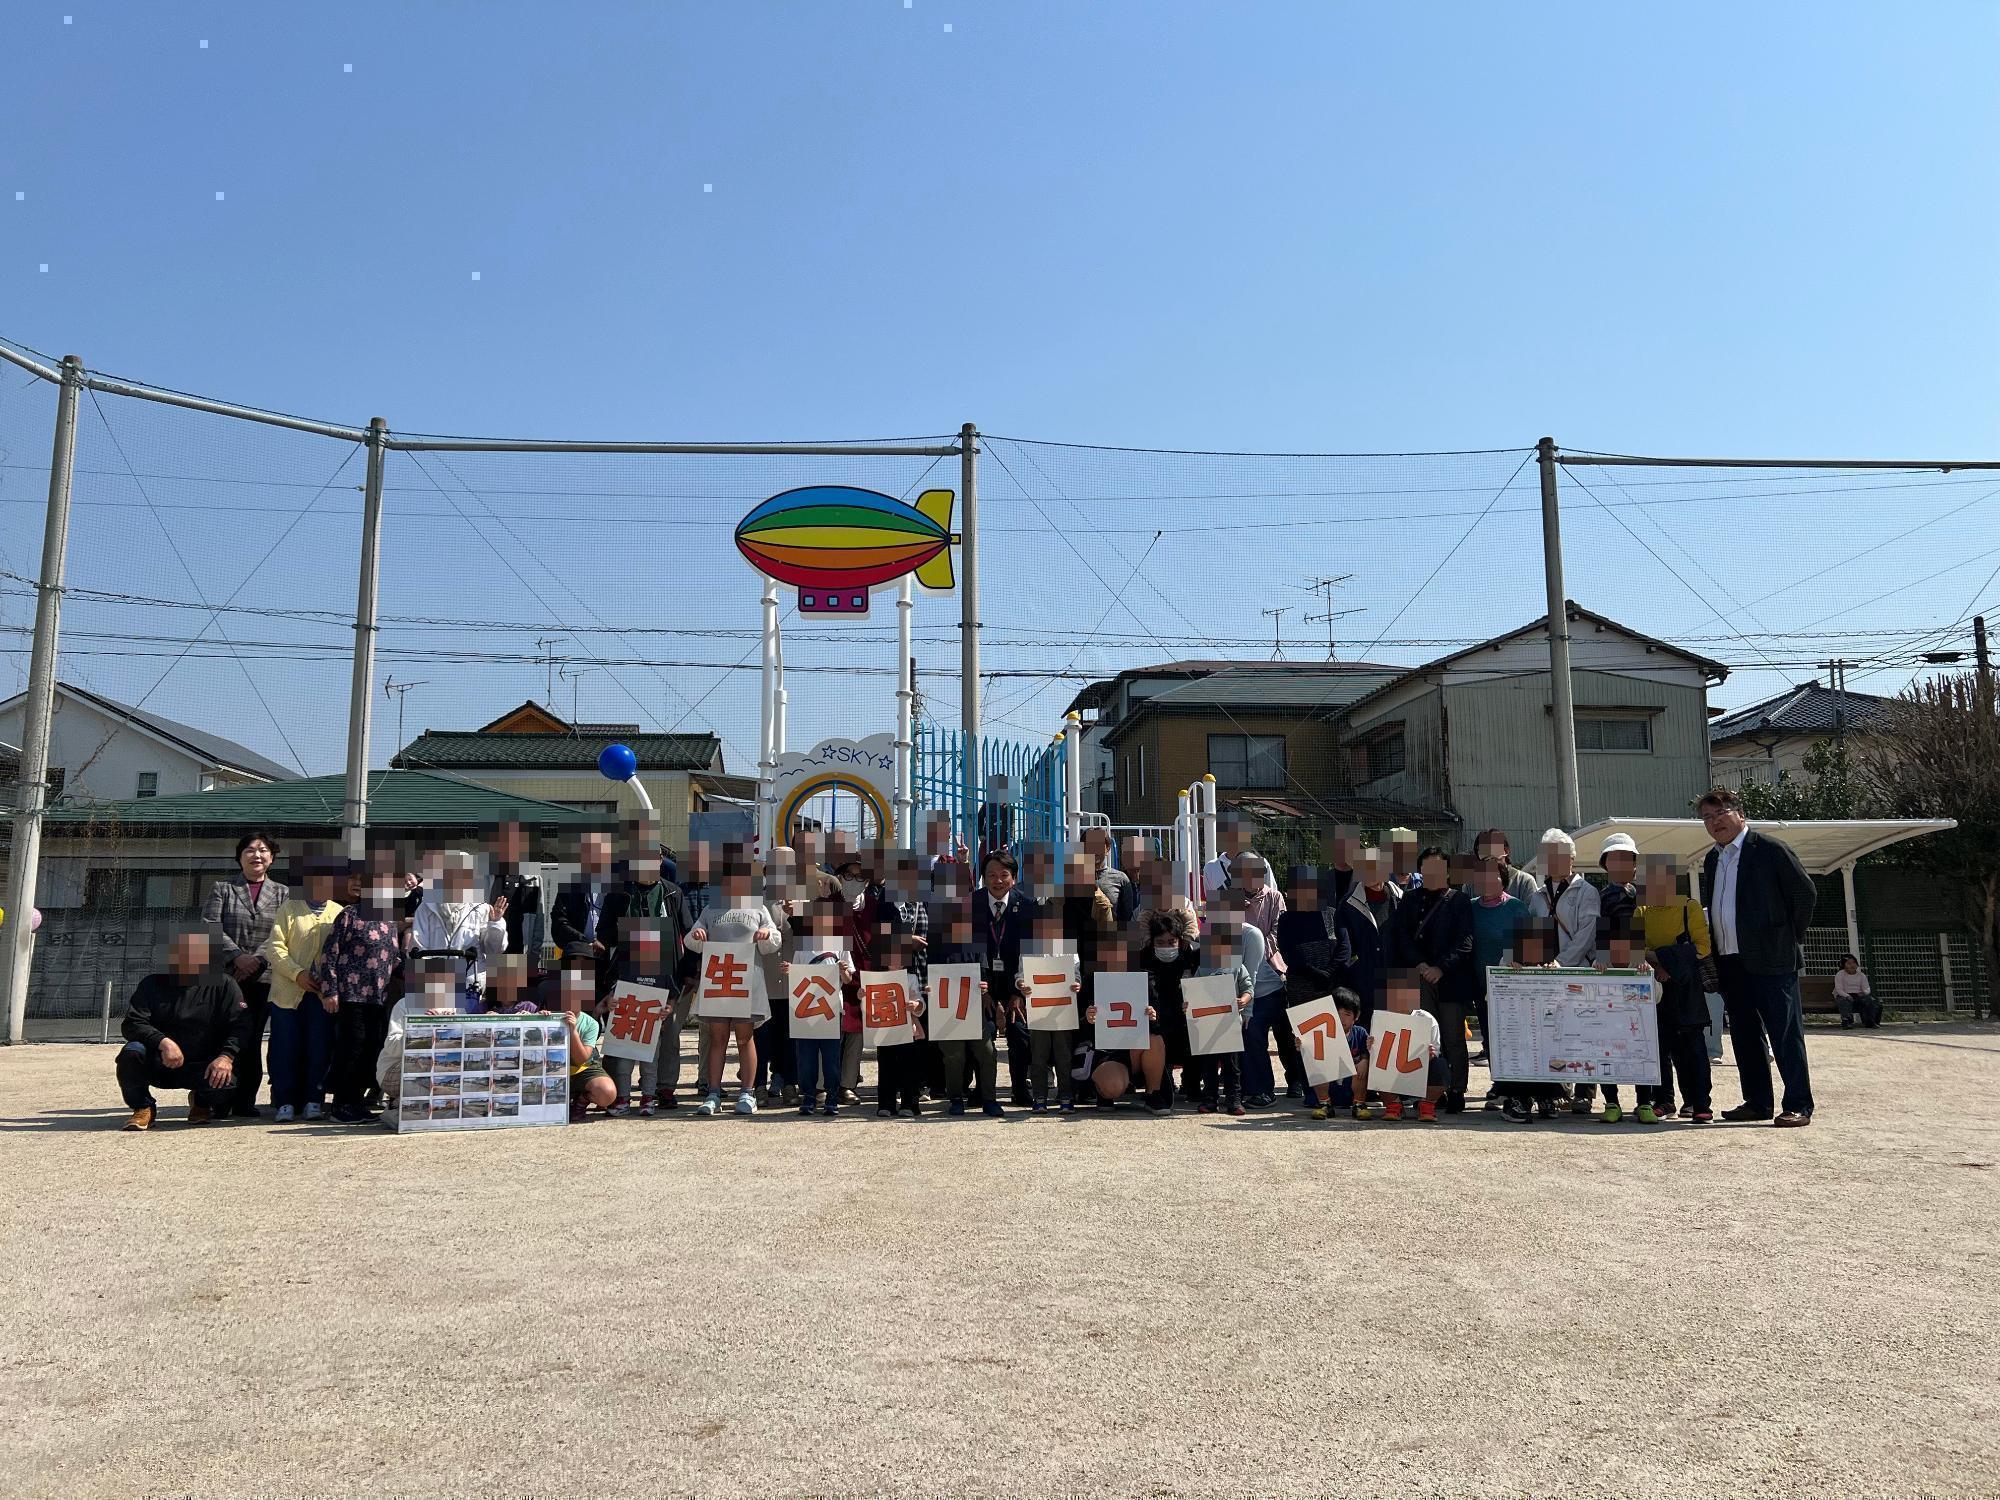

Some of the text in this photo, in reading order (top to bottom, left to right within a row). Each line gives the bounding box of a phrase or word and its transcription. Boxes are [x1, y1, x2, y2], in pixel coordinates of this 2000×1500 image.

[837, 747, 879, 766] SKY
[704, 953, 749, 998] 生
[793, 975, 836, 1021] 公
[1031, 974, 1072, 1007] ニ
[610, 994, 662, 1044] 新
[866, 982, 907, 1028] 園
[939, 977, 971, 1020] リ
[1298, 1012, 1336, 1060] ア
[1375, 1029, 1422, 1073] ル
